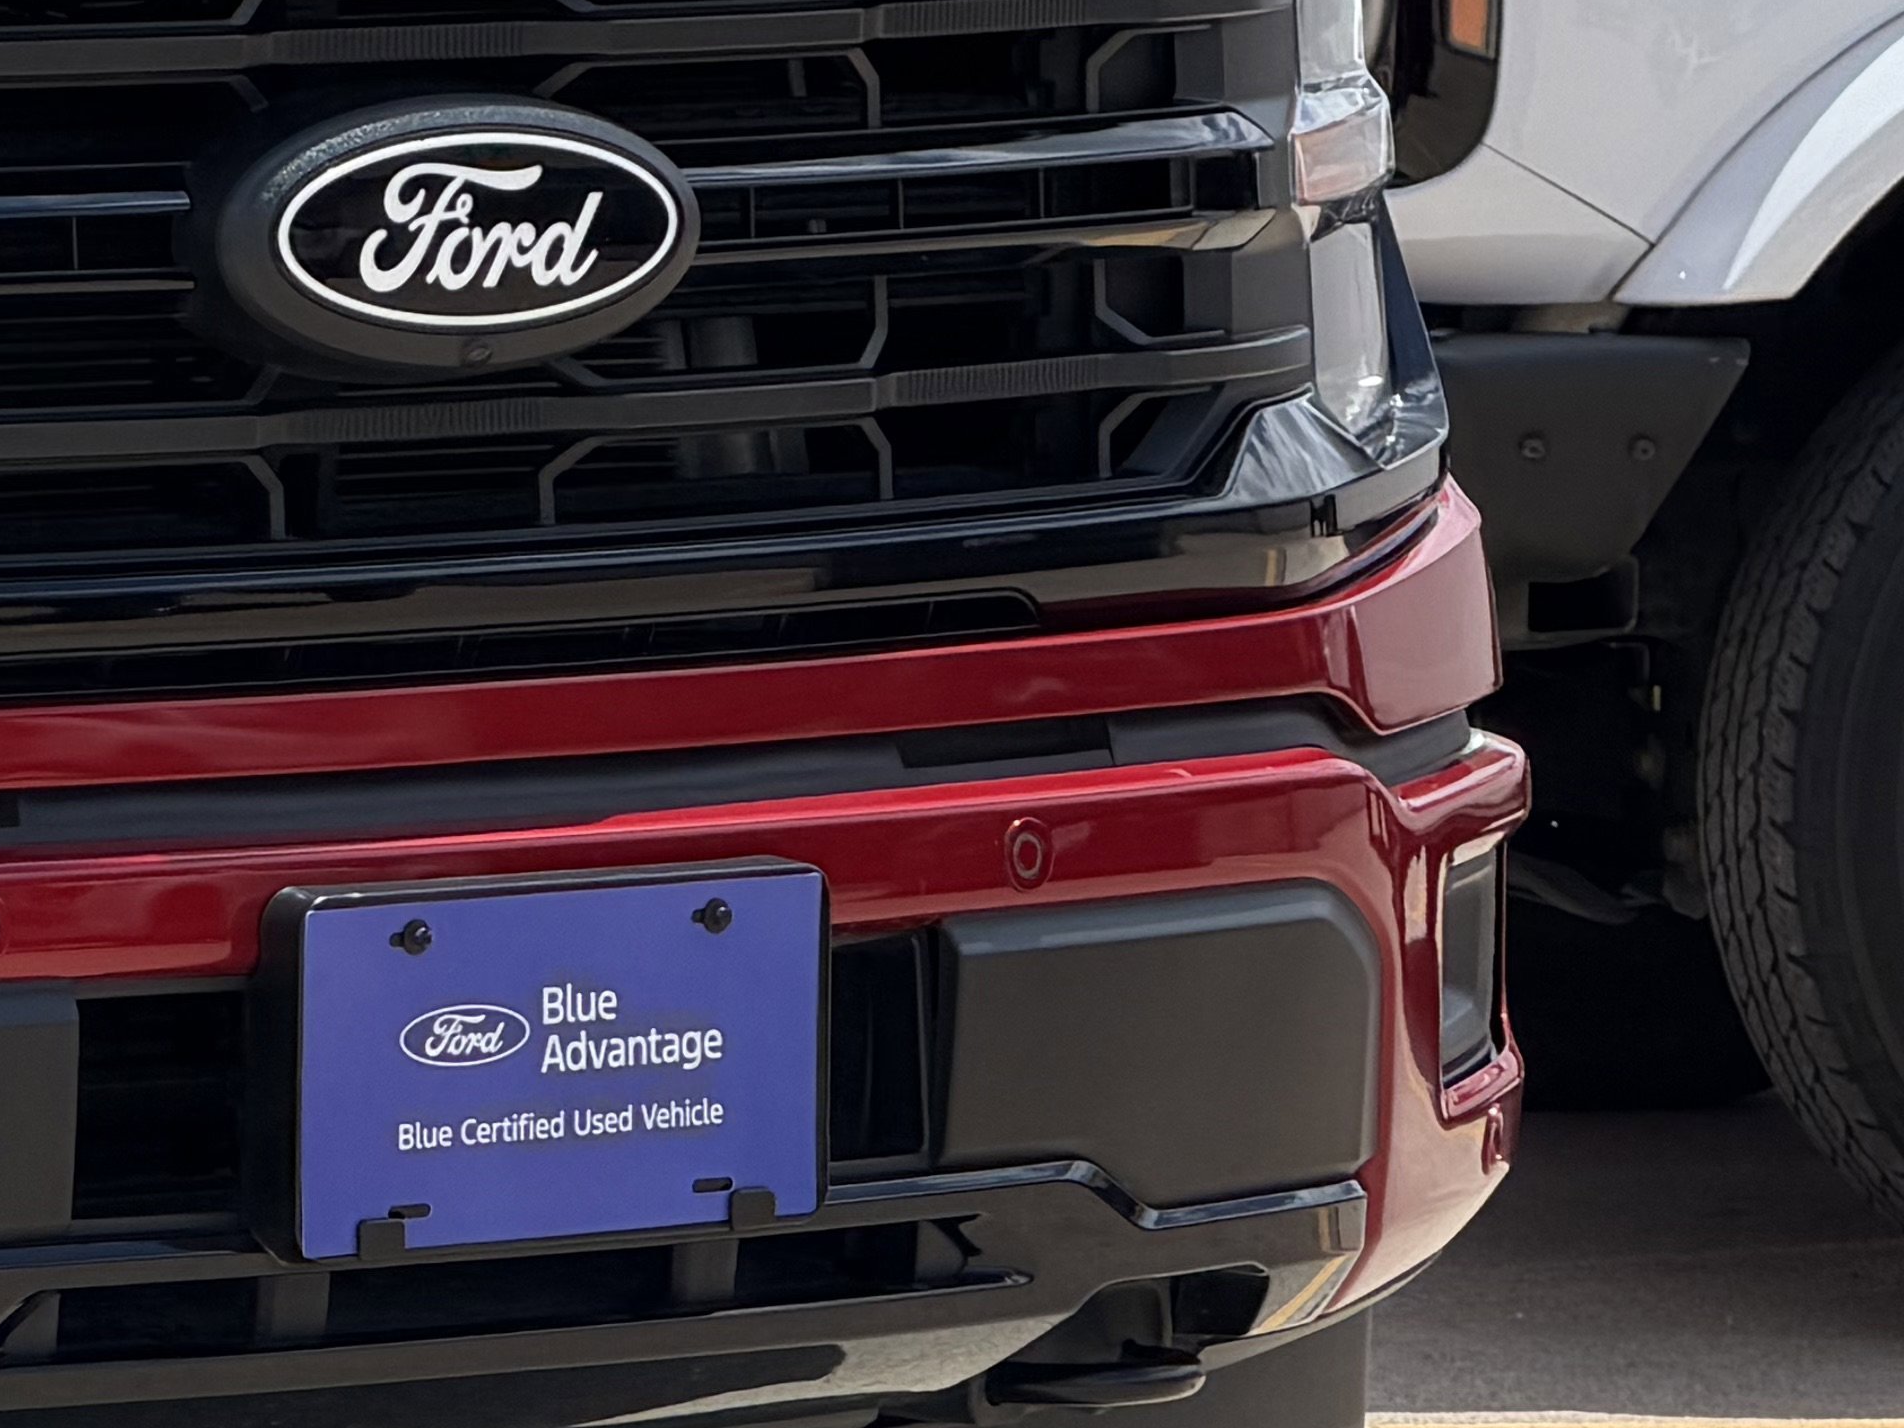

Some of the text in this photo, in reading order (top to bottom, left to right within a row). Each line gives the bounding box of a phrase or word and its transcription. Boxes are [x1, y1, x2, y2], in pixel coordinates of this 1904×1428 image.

[359, 162, 603, 293] Ford
[542, 983, 618, 1026] Blue
[425, 1013, 505, 1057] Ford
[540, 1026, 723, 1074] Advantage
[398, 1098, 724, 1151] Blue Certified Used Vehicle
